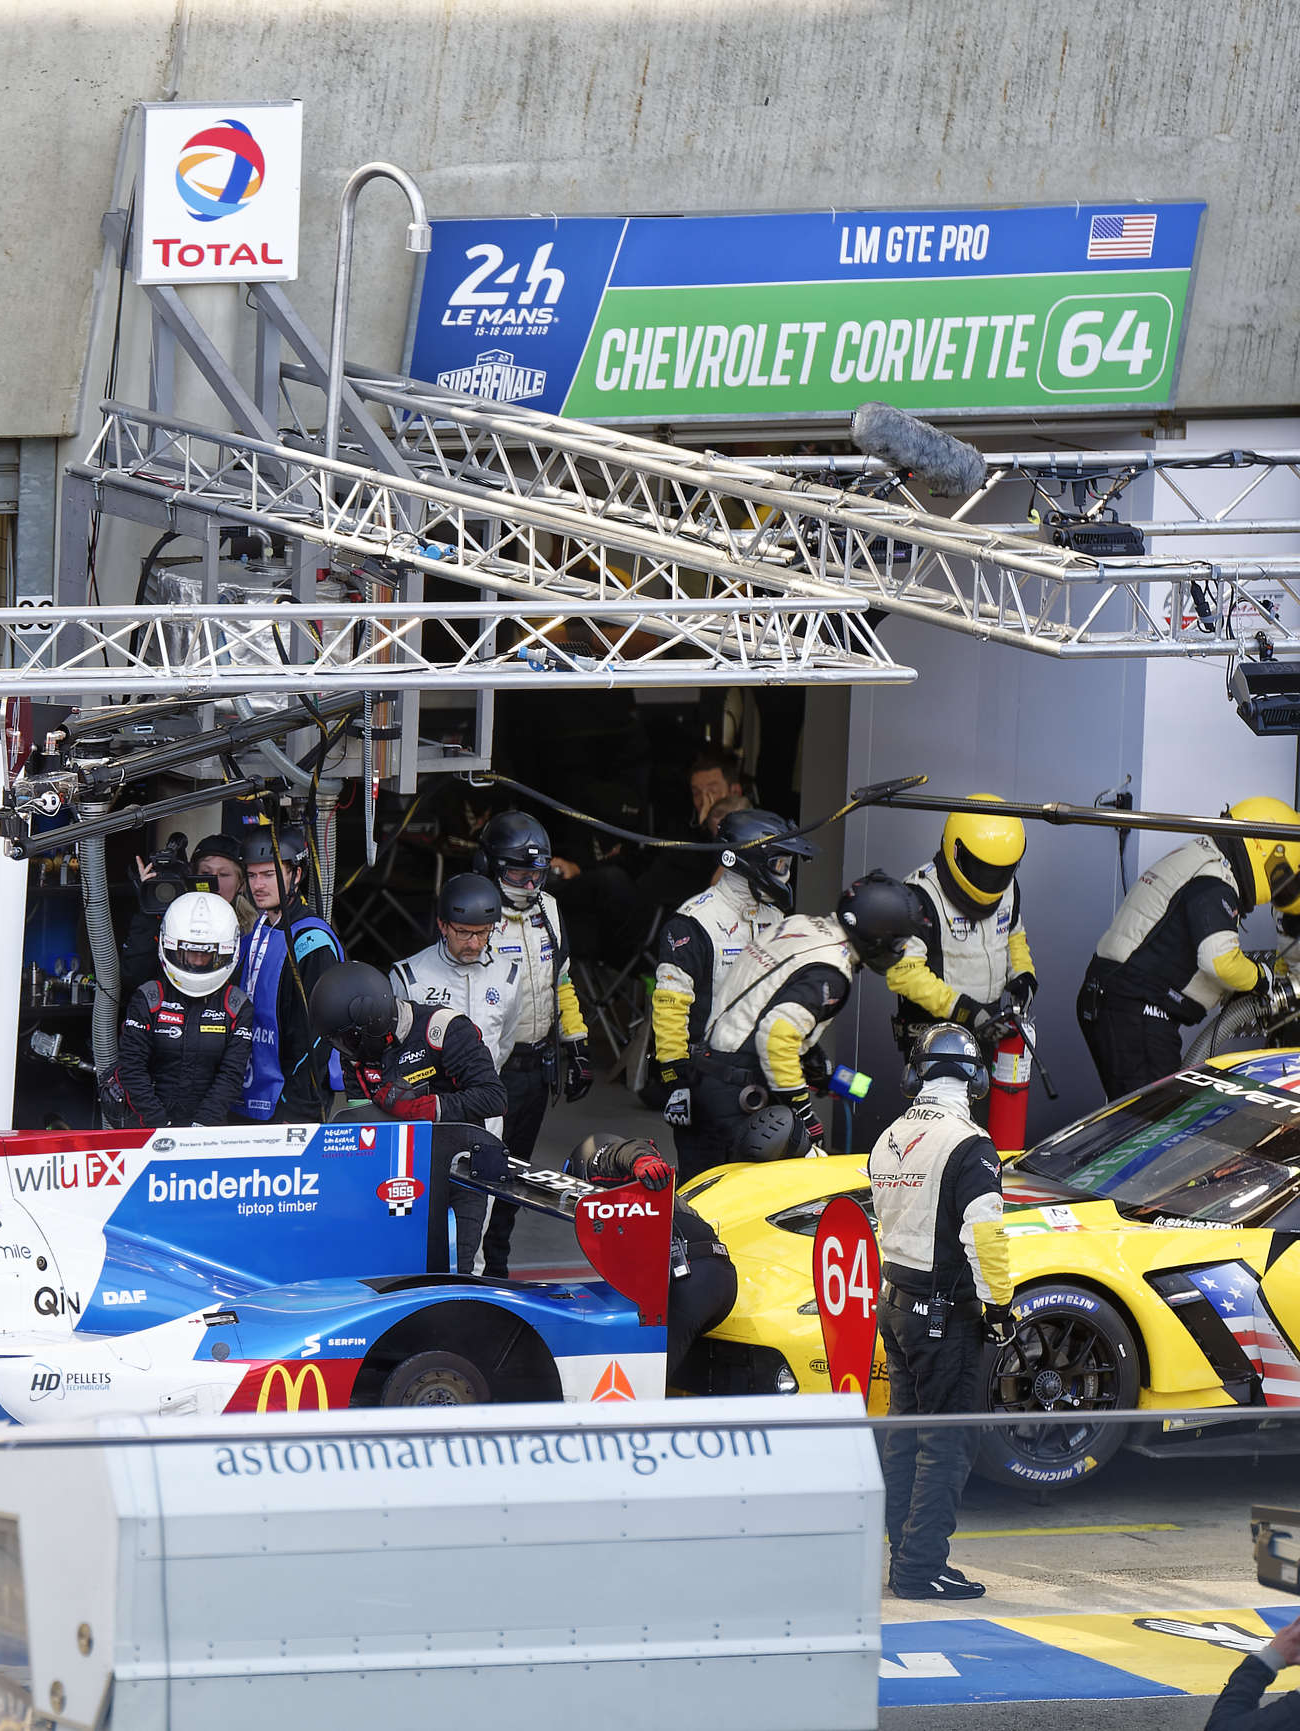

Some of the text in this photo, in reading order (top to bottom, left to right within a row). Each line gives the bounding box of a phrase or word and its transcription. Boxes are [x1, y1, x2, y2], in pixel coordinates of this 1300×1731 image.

[152, 238, 283, 268] TOTAL
[840, 224, 989, 264] LM GTE PRO
[447, 242, 566, 306] 24h
[441, 309, 476, 326] LE
[595, 309, 1152, 391] CHEVROLET CORVETTE 64
[148, 1168, 319, 1202] binderholz
[387, 1186, 414, 1198] 1969
[238, 1201, 318, 1217] tiptop timber
[583, 1202, 660, 1219] TOTAL
[822, 1236, 873, 1318] 64
[102, 1290, 147, 1305] DAF
[1033, 1294, 1095, 1311] MICHELIN
[328, 1338, 366, 1347] SERFIM
[30, 1373, 111, 1391] HD PELLETS
[215, 1427, 773, 1477] astonmartinracing.com
[1010, 1461, 1074, 1481] MICHELIN
